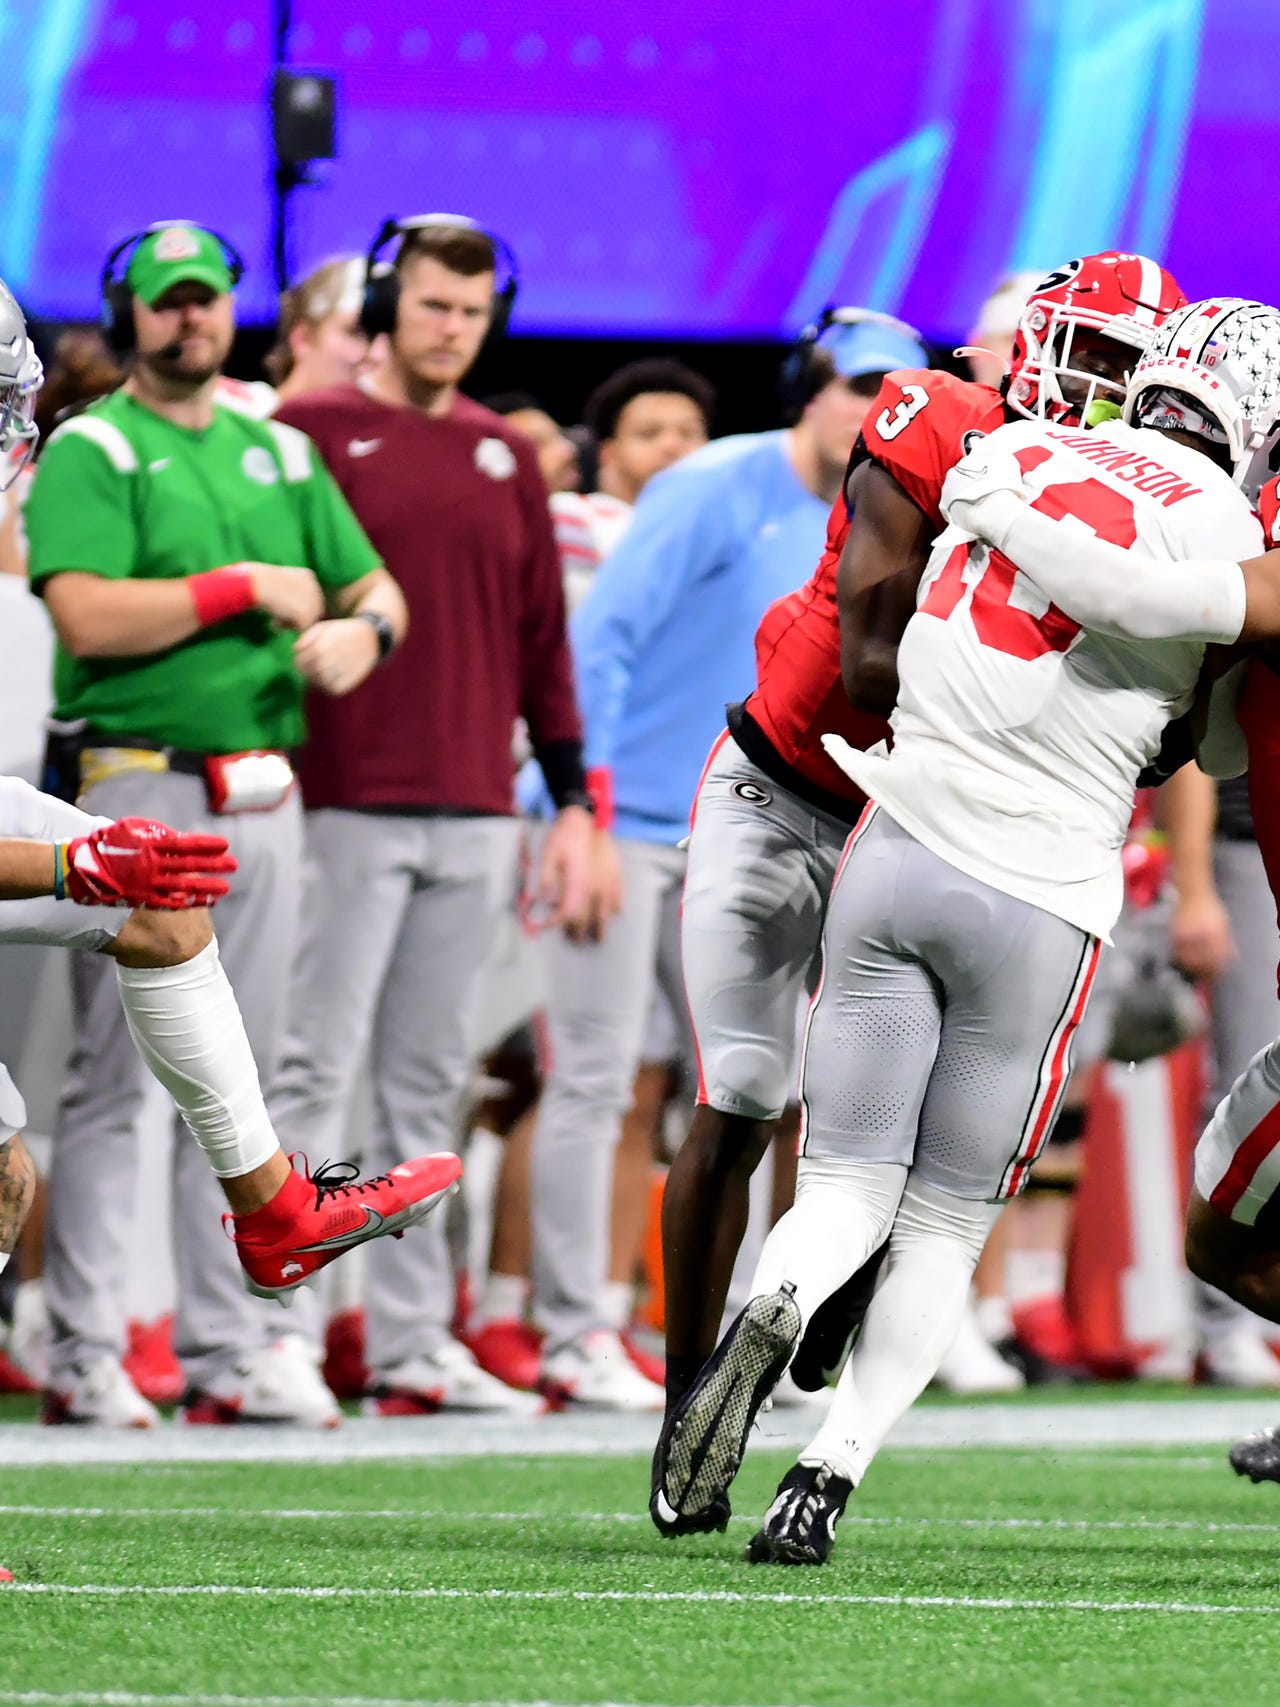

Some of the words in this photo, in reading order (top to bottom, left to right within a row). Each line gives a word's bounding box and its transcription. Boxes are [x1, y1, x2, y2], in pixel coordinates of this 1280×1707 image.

[1139, 358, 1220, 390] BUCKEYES
[1203, 354, 1216, 367] 10
[885, 385, 930, 441] 3
[1045, 431, 1204, 507] JOHNSON
[734, 782, 769, 802] G
